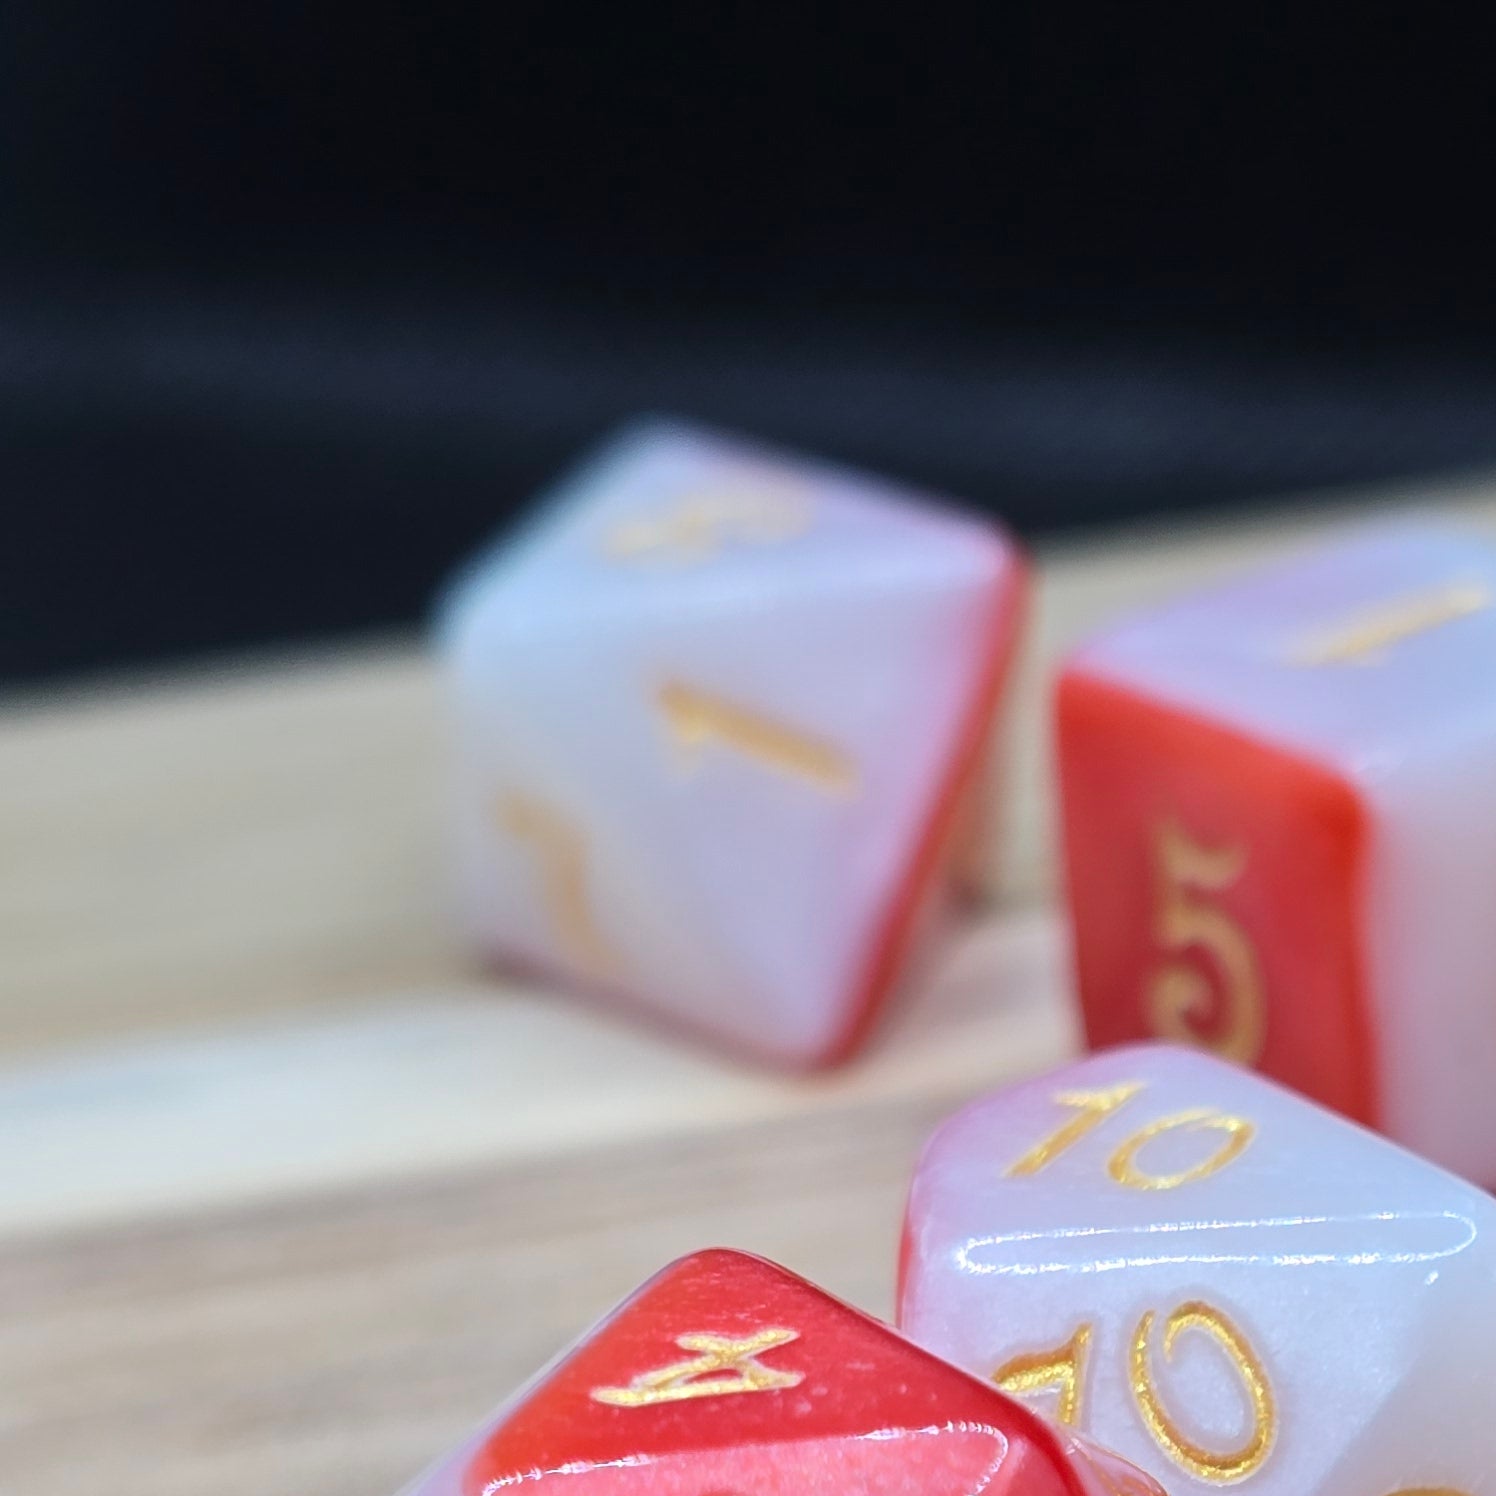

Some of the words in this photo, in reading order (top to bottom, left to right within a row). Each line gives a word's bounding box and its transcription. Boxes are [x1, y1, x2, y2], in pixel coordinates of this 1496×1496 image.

[1146, 812, 1270, 1070] 5
[1002, 1080, 1258, 1192] 10
[588, 1326, 808, 1409] 4
